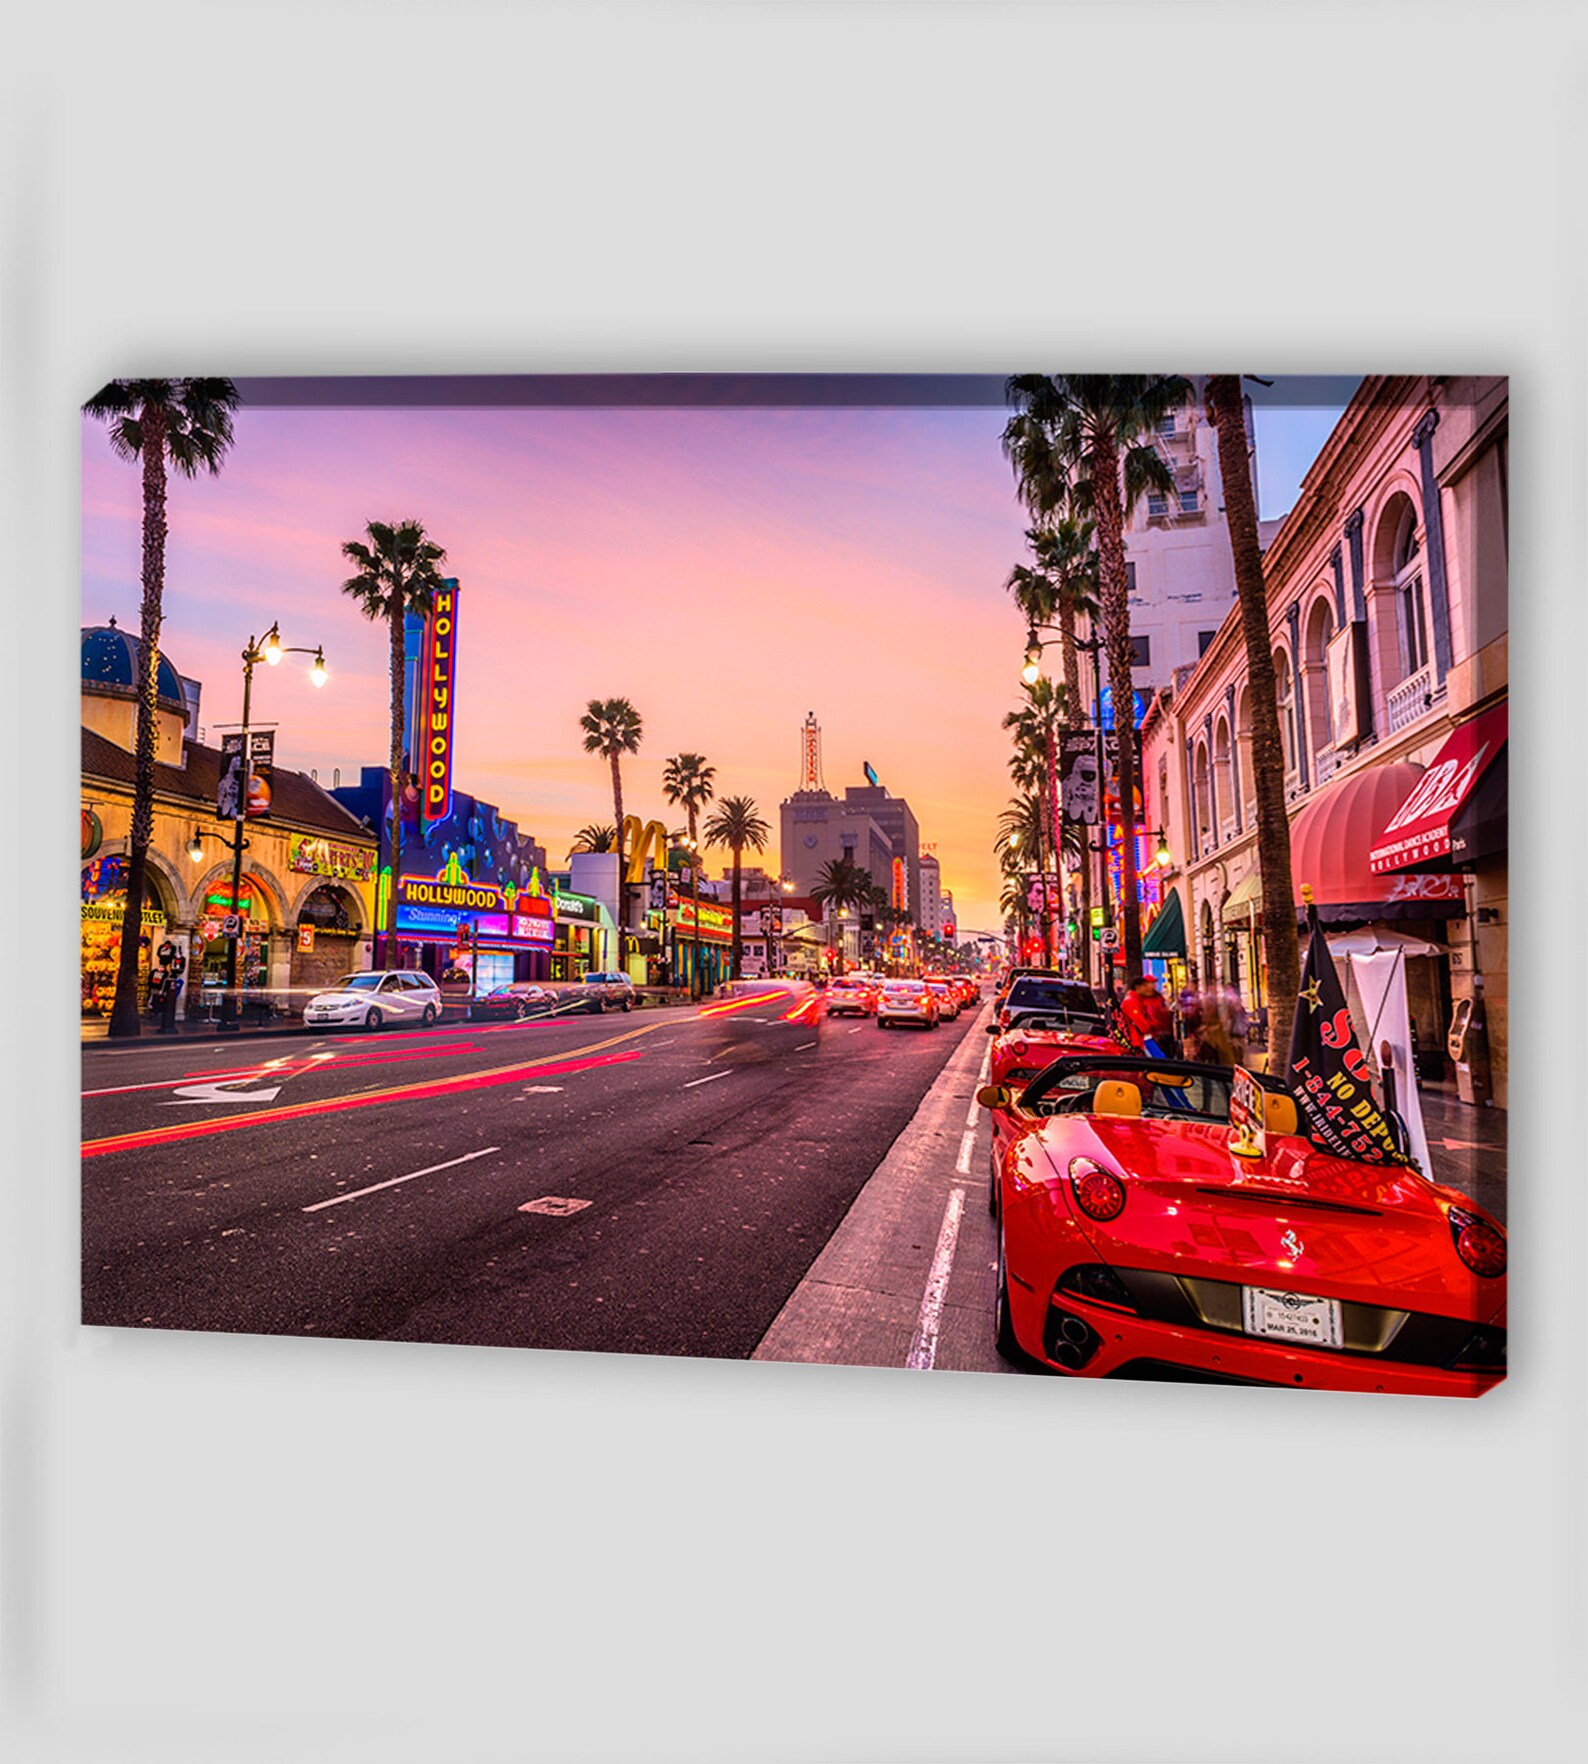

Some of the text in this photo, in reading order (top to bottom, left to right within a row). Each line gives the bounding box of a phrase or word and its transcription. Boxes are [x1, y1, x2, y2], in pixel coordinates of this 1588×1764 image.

[430, 595, 451, 803] HOLLYWOOD
[1371, 838, 1451, 872] HOLLYWOOD
[407, 883, 496, 908] HOLLYWOOD
[81, 906, 126, 921] SOUVENI
[1326, 1071, 1356, 1100] NO
